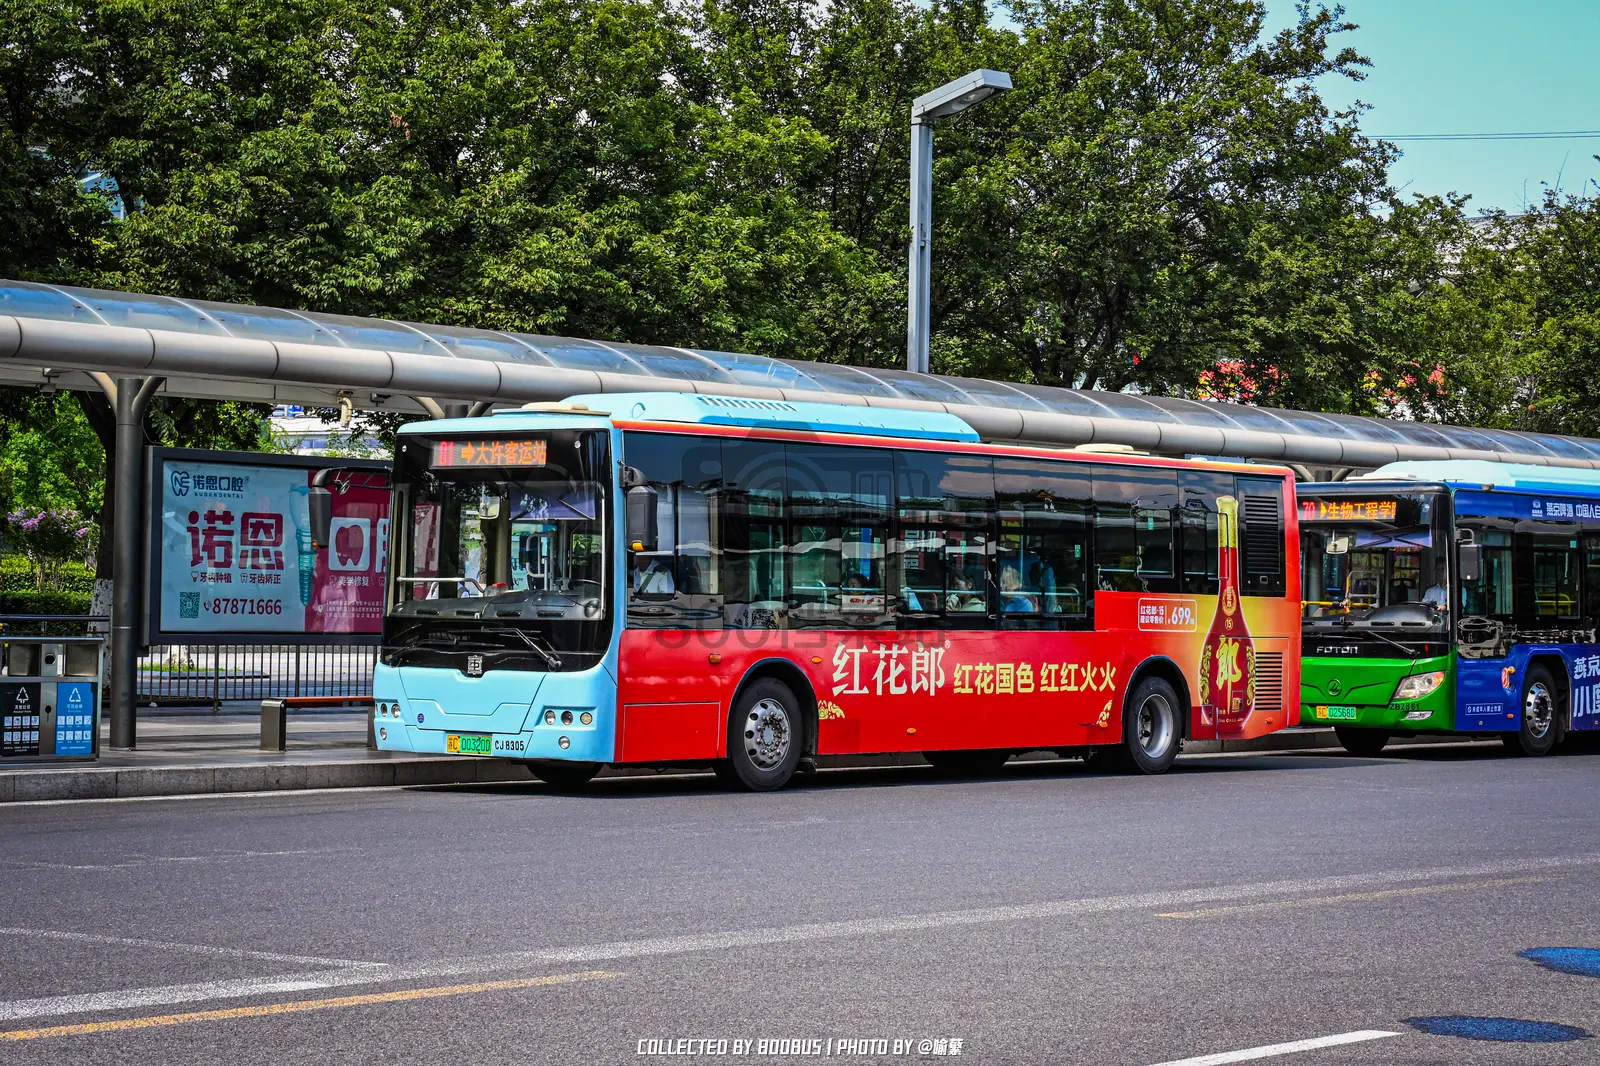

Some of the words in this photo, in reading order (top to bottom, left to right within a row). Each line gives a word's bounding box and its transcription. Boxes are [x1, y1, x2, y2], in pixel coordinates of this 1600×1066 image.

[475, 441, 546, 465] 大许客运站
[193, 475, 243, 492] 诺恩口腔
[186, 509, 284, 570] 诺恩
[212, 598, 282, 615] 87871666
[1316, 646, 1358, 654] FOTON
[831, 640, 945, 697] 红花郎
[953, 662, 1034, 695] 红花国色
[1039, 661, 1117, 693] 红红火火
[495, 740, 524, 751] CJ8305
